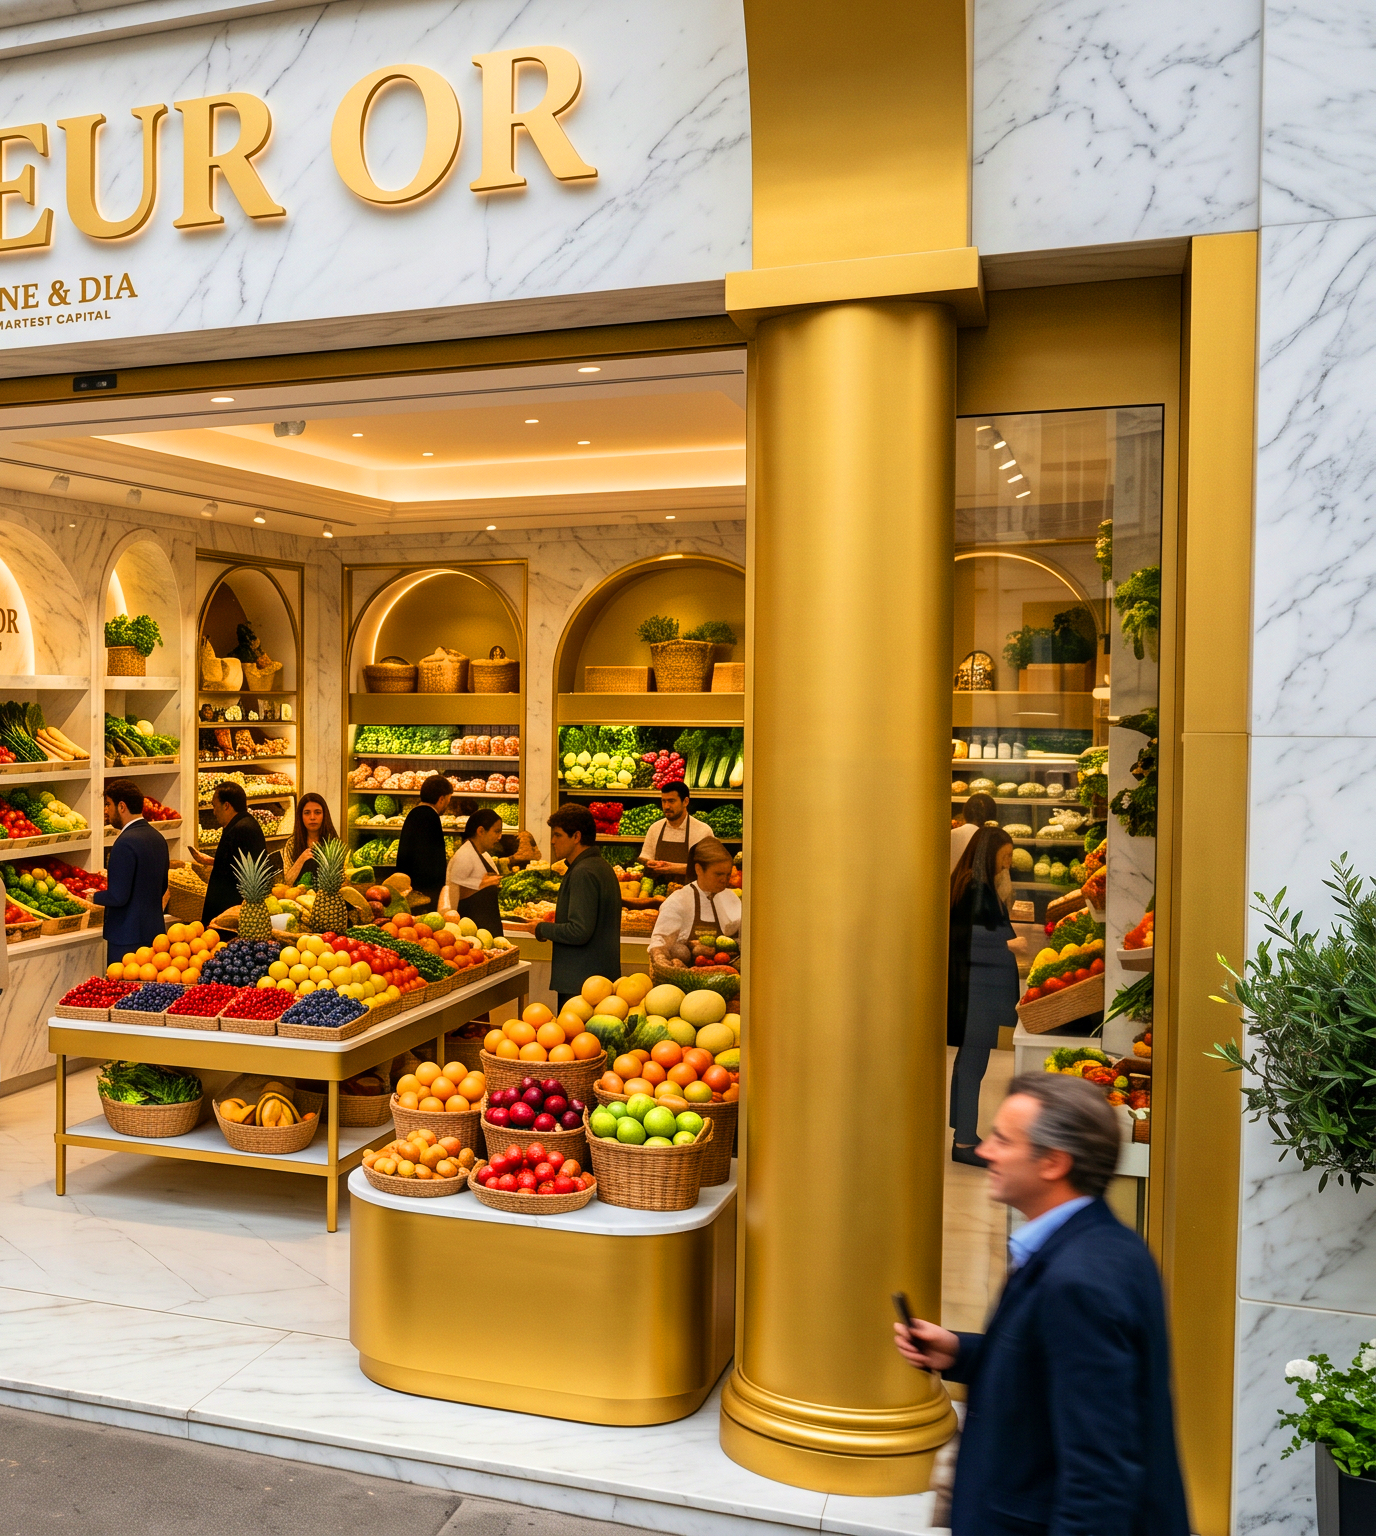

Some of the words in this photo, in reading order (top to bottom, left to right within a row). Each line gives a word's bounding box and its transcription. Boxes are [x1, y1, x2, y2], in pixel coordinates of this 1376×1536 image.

[330, 44, 600, 206] OR
[47, 279, 71, 307] &
[78, 272, 138, 304] DIA
[56, 309, 111, 325] CAPITAL
